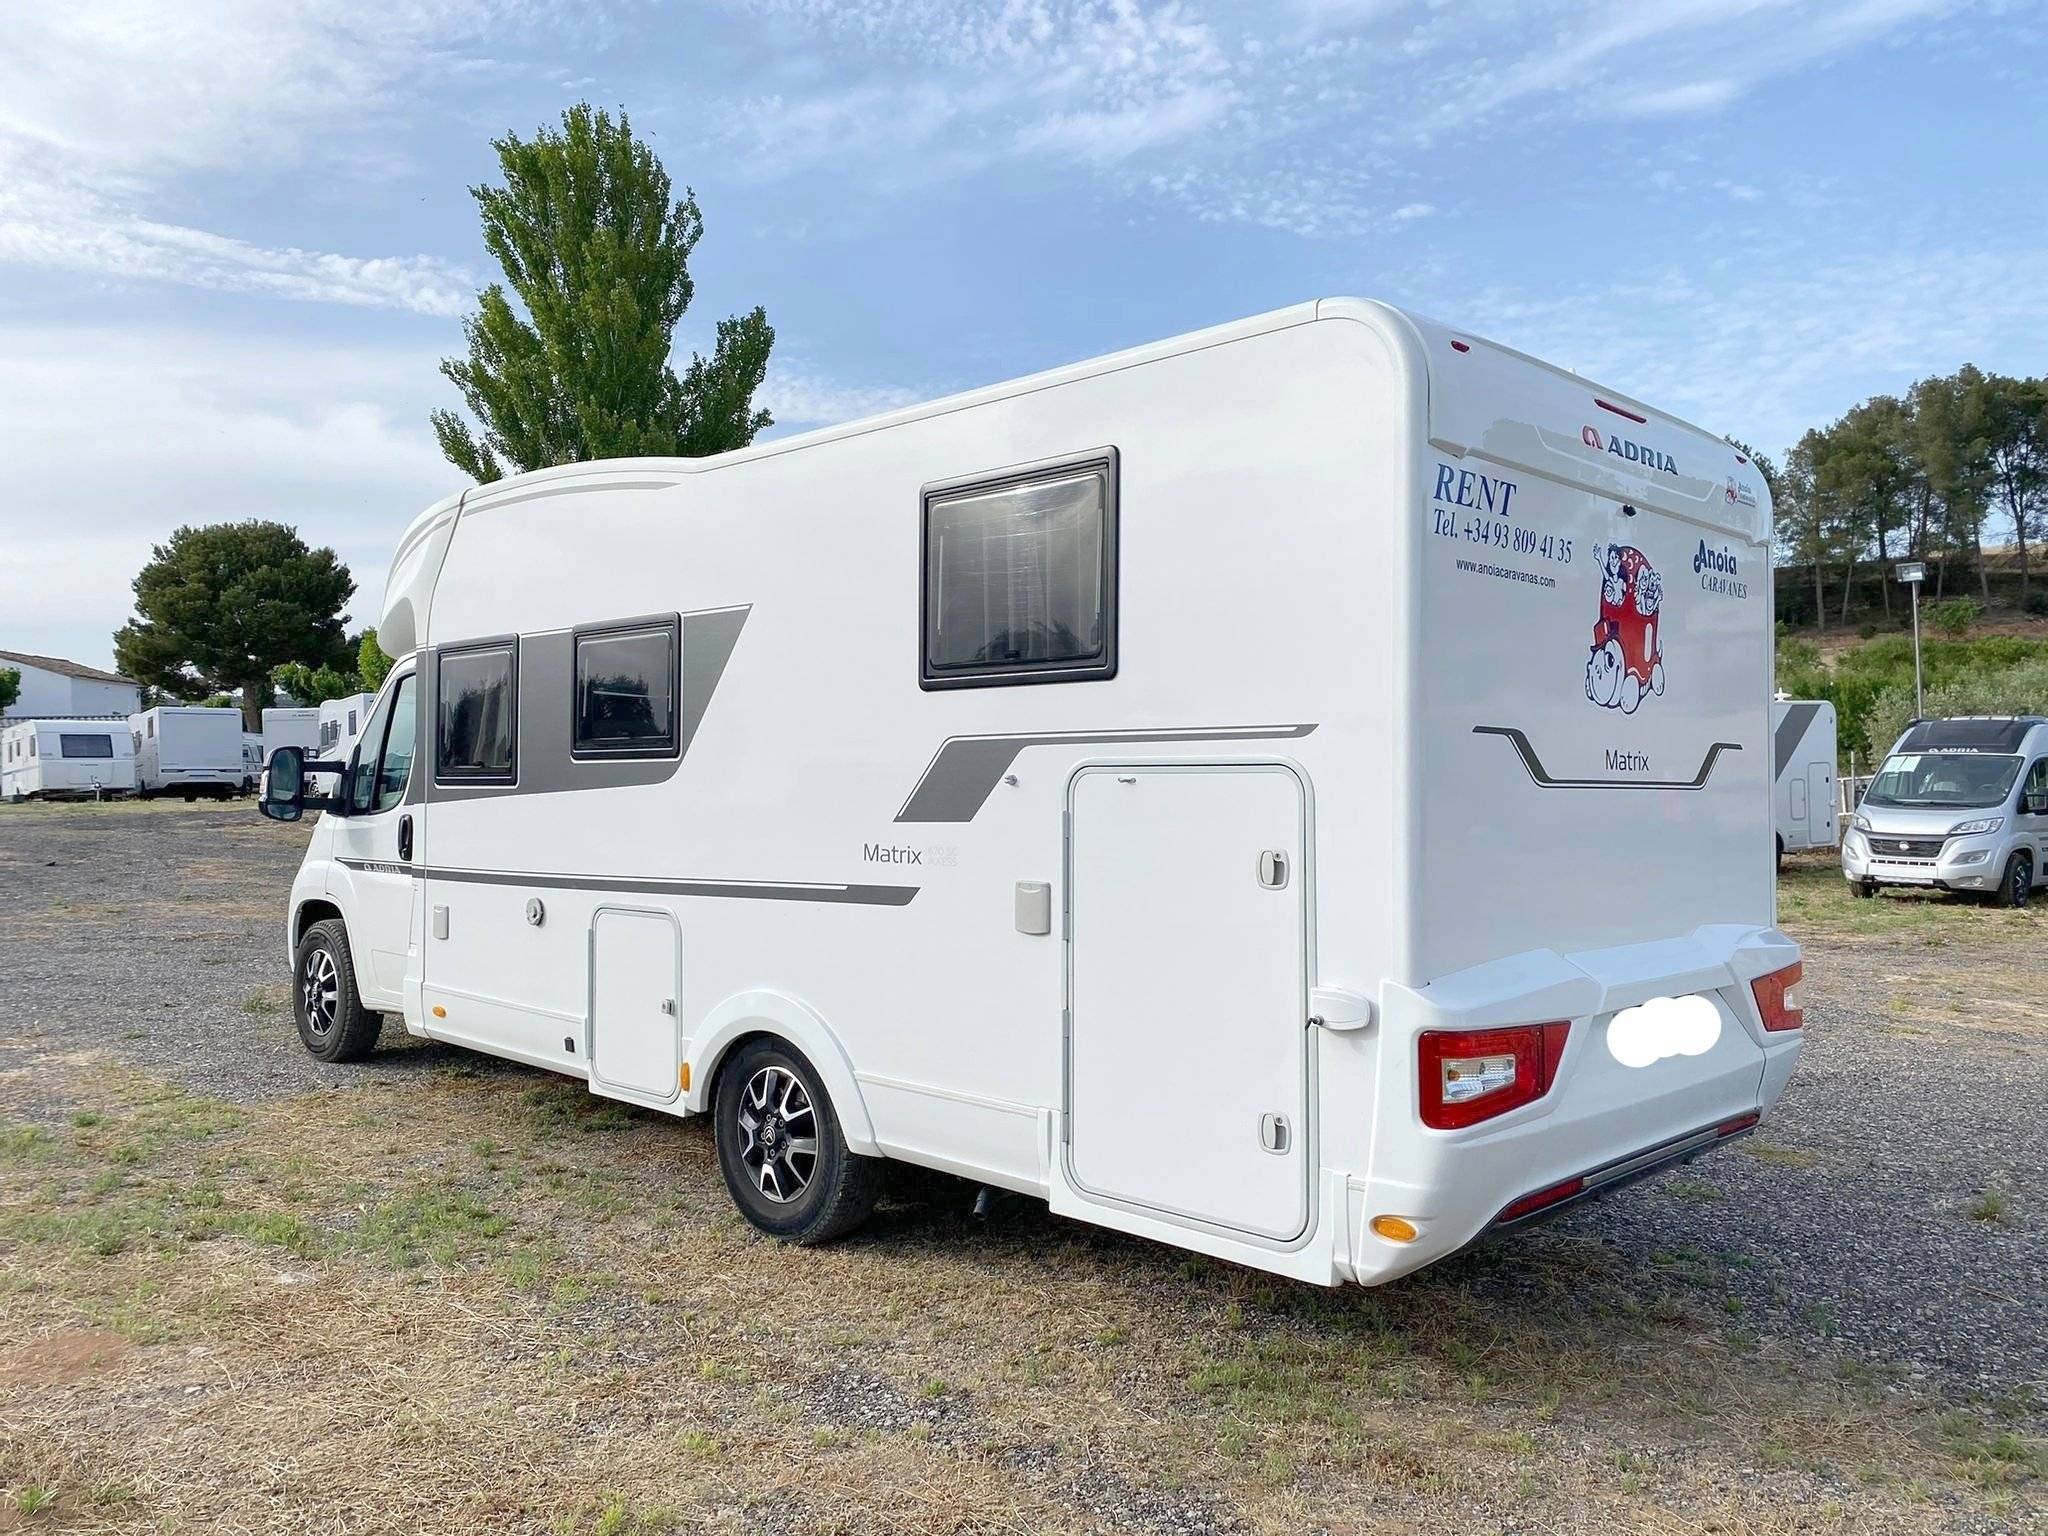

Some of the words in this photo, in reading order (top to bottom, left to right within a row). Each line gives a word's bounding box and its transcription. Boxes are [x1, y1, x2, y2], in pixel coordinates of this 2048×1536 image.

[1608, 434, 1678, 476] ADRIA
[1433, 463, 1517, 517] RENT
[1434, 508, 1458, 538] Tel.
[1463, 518, 1490, 545] +34
[1493, 522, 1509, 549] 93
[1513, 527, 1536, 554] 809
[1540, 534, 1554, 559] 41
[1557, 538, 1572, 563] 35
[1456, 559, 1556, 588] www.anoiacaravanas.com
[1693, 538, 1737, 576] Anoia
[1701, 573, 1748, 600] CARAVANES
[1605, 749, 1650, 771] Matrix
[863, 843, 922, 865] Matrix
